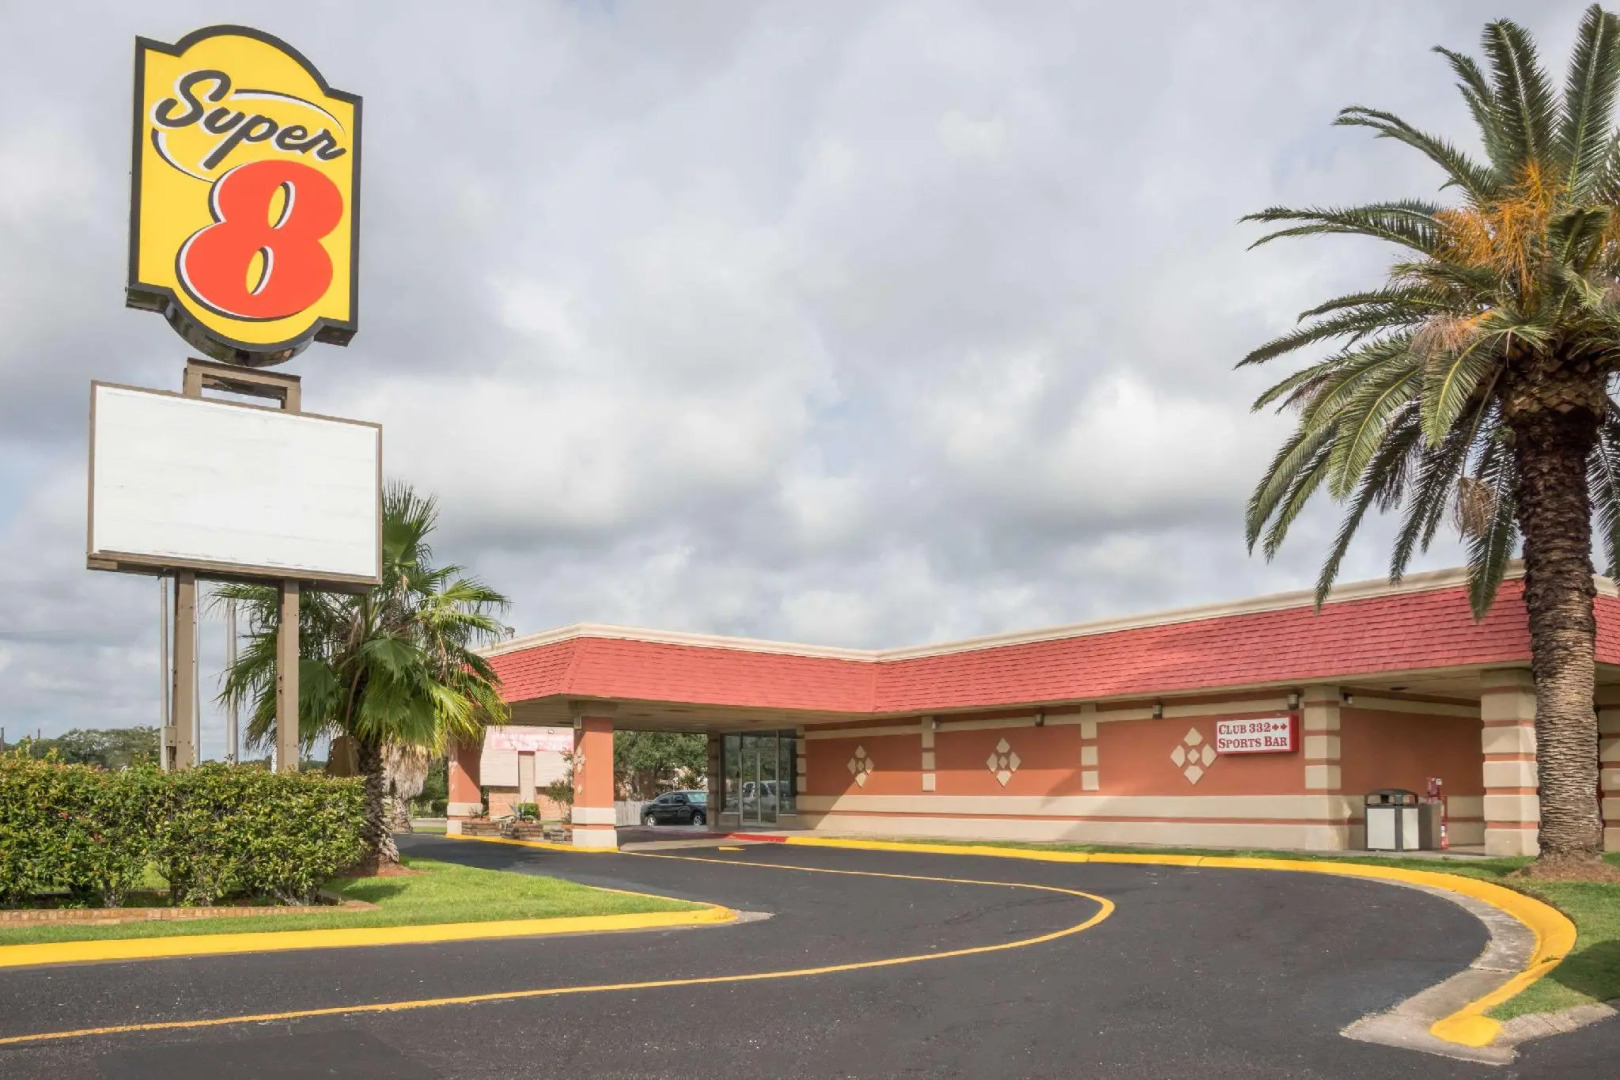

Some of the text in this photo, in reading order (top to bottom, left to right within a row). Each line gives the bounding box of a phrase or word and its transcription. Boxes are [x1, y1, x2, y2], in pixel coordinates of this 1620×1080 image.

[154, 69, 347, 171] Super
[175, 160, 343, 322] 8
[1218, 722, 1271, 735] CLUB 332
[1218, 735, 1288, 749] SPORTS BAR
